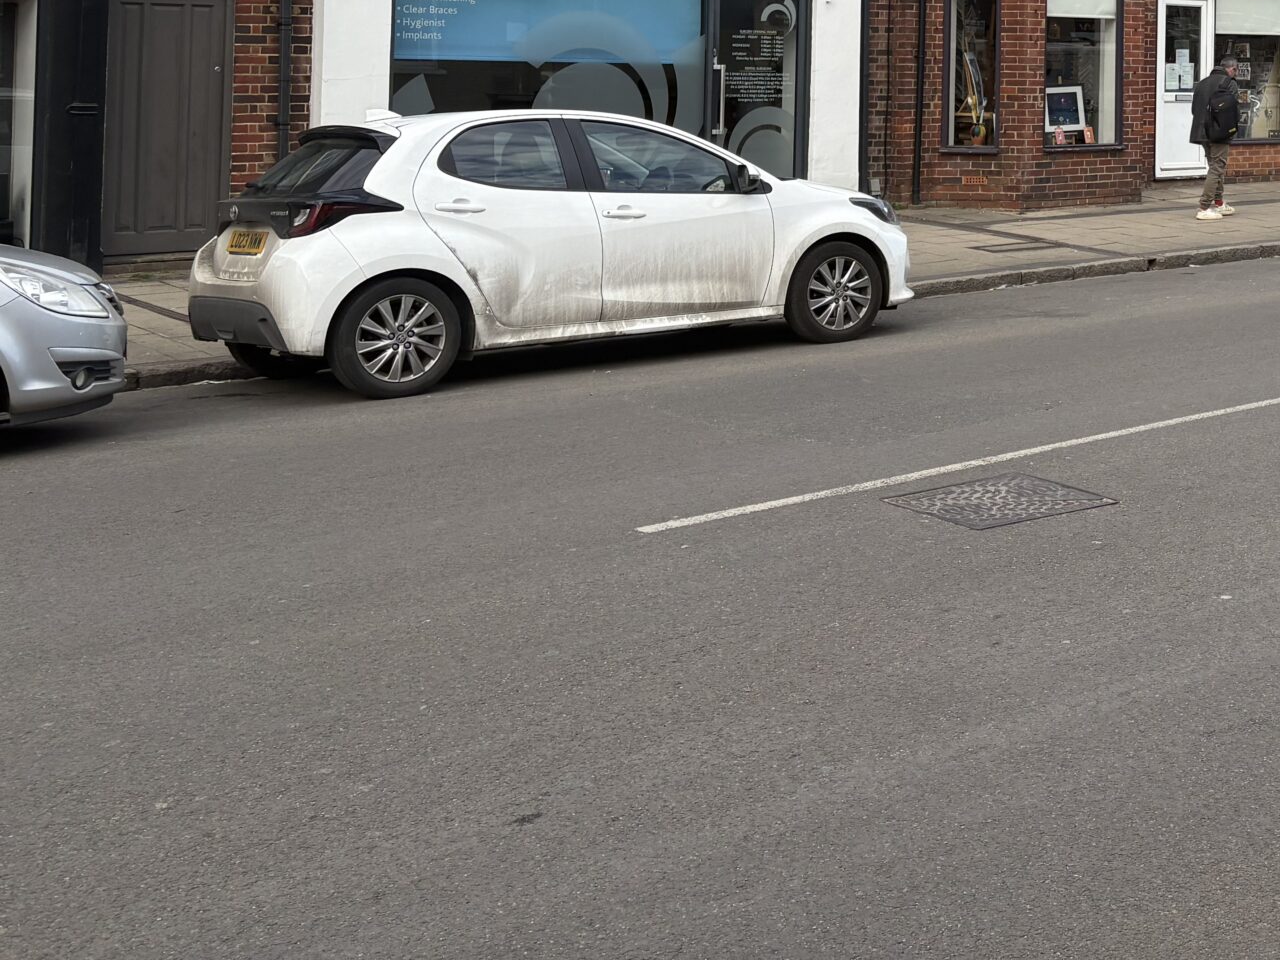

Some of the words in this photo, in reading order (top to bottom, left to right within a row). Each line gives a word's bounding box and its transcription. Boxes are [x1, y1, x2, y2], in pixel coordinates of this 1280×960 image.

[403, 5, 427, 14] Clear
[429, 5, 458, 15] Braces
[402, 18, 445, 29] Hygienist
[402, 31, 442, 41] Implants
